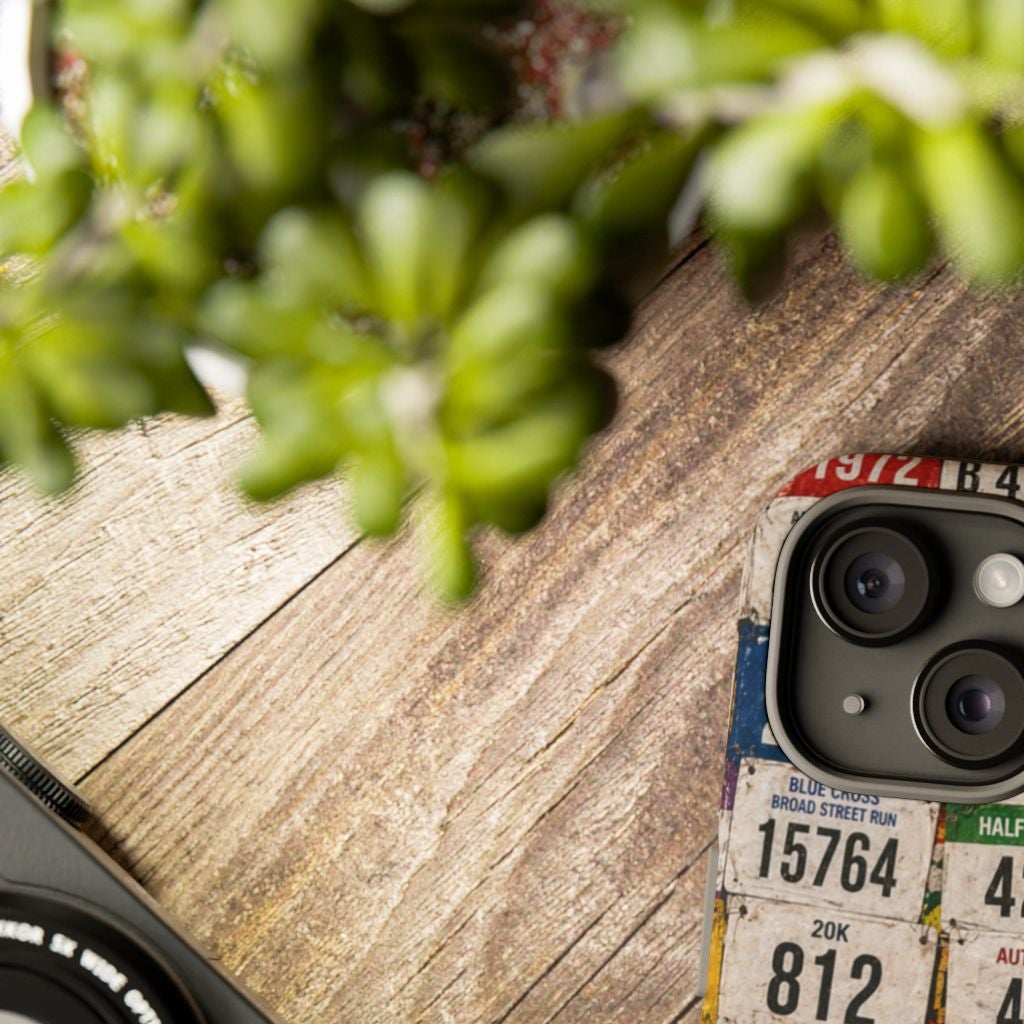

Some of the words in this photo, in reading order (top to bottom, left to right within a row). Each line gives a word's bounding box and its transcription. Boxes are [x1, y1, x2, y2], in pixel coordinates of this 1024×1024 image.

[789, 776, 826, 797] BLUE
[771, 794, 817, 814] BROAD
[820, 802, 866, 822] STREET
[870, 810, 898, 827] RUN
[979, 816, 1024, 837] HALF
[758, 818, 899, 897] 15764
[811, 919, 850, 942] 20K
